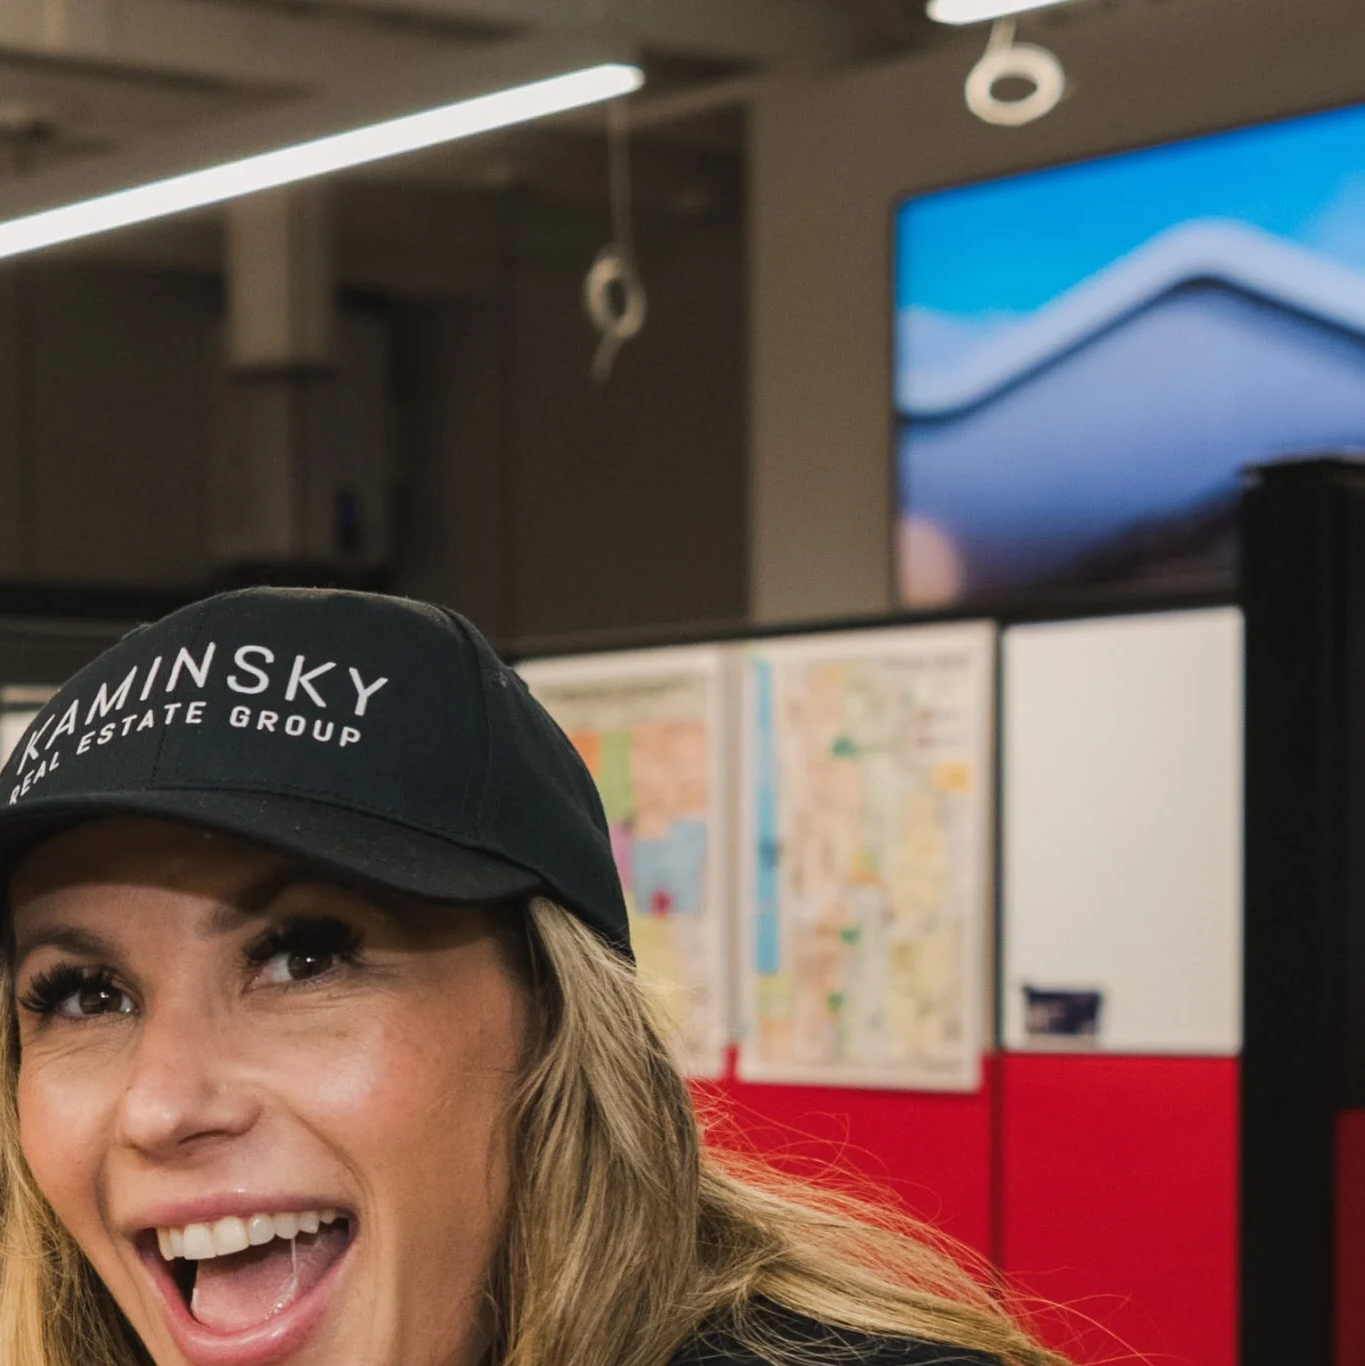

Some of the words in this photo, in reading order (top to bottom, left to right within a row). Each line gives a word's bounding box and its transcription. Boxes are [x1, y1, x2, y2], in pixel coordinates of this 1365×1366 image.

[9, 751, 60, 805] REAL
[76, 701, 207, 755] ESTATE
[229, 705, 362, 747] GROUP
[16, 642, 389, 776] KAMINSKY
